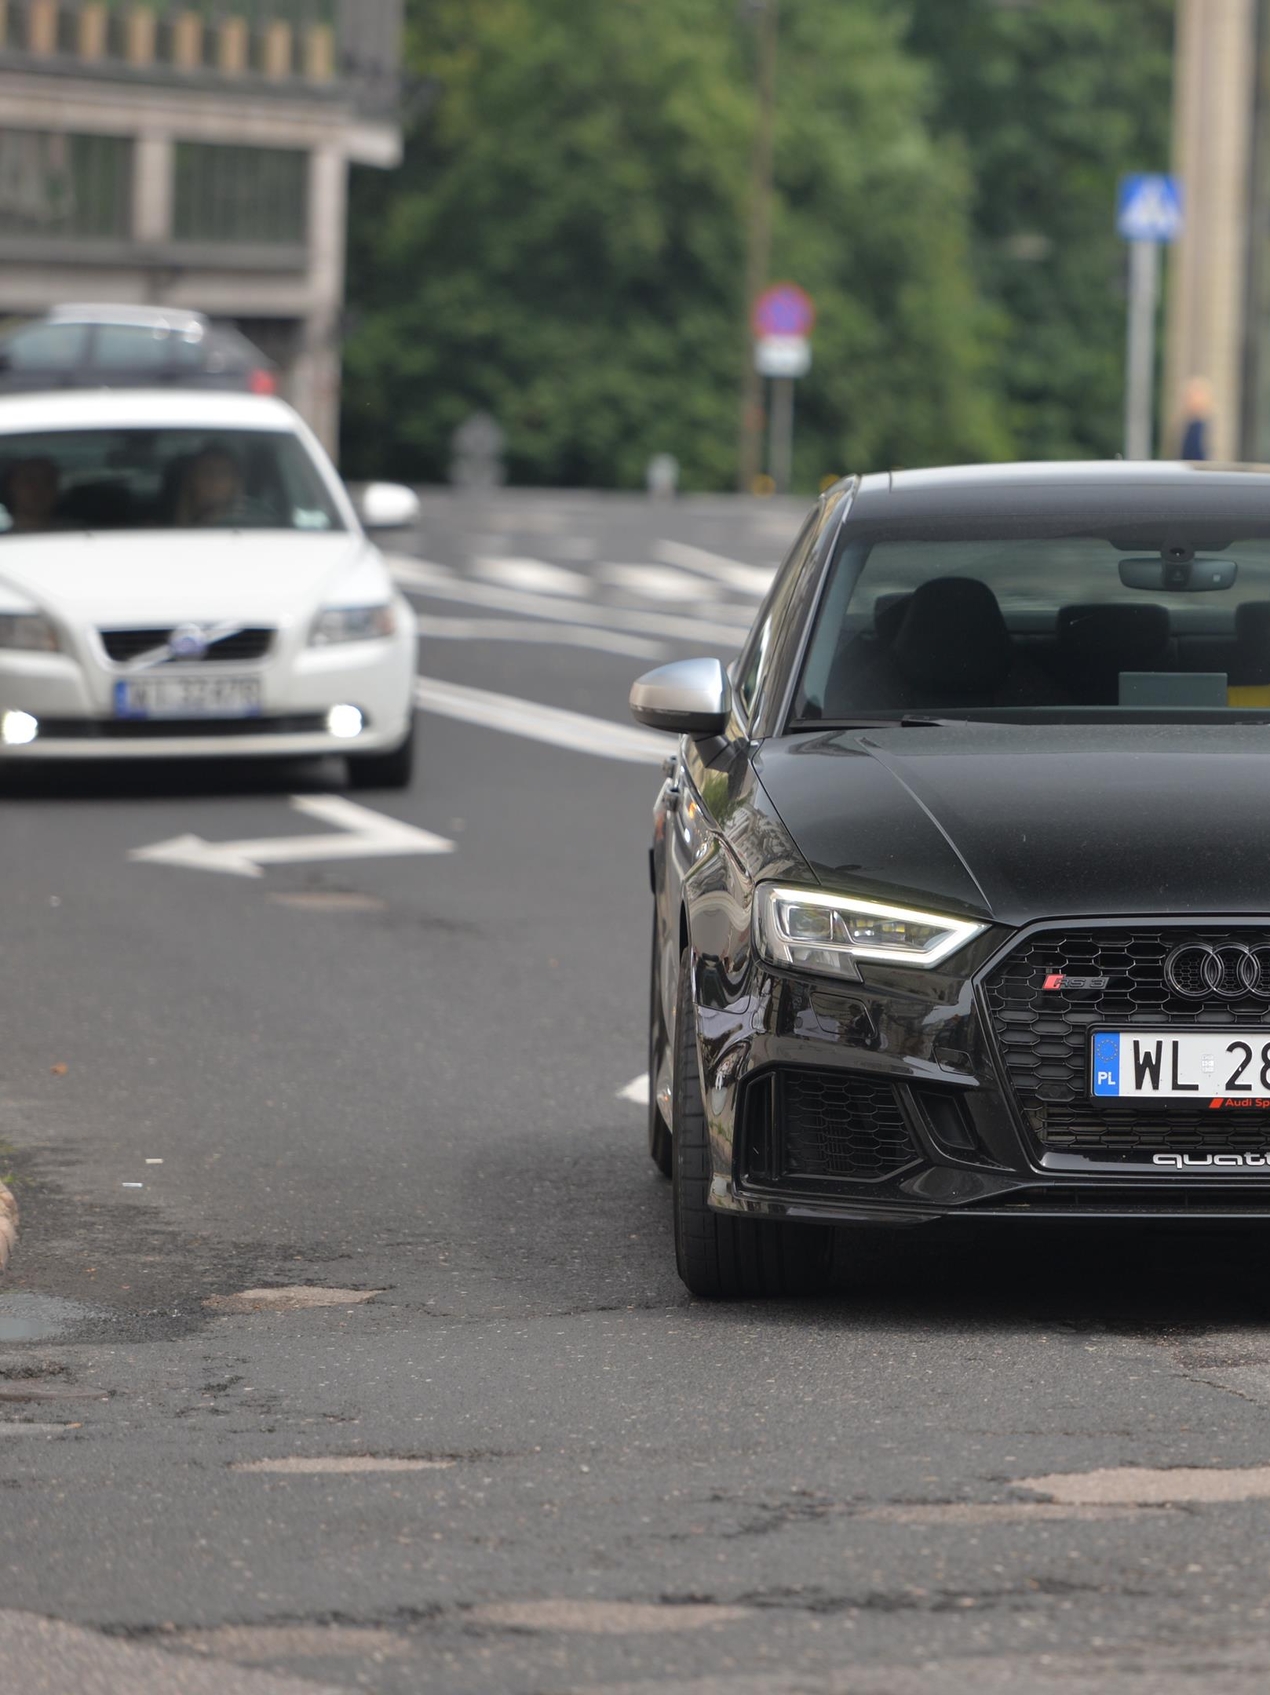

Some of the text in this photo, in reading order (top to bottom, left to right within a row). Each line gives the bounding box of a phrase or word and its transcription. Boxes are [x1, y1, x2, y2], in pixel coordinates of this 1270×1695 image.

[1133, 1040, 1199, 1091] WL
[1097, 1071, 1116, 1086] PL
[1225, 1098, 1252, 1107] Audi
